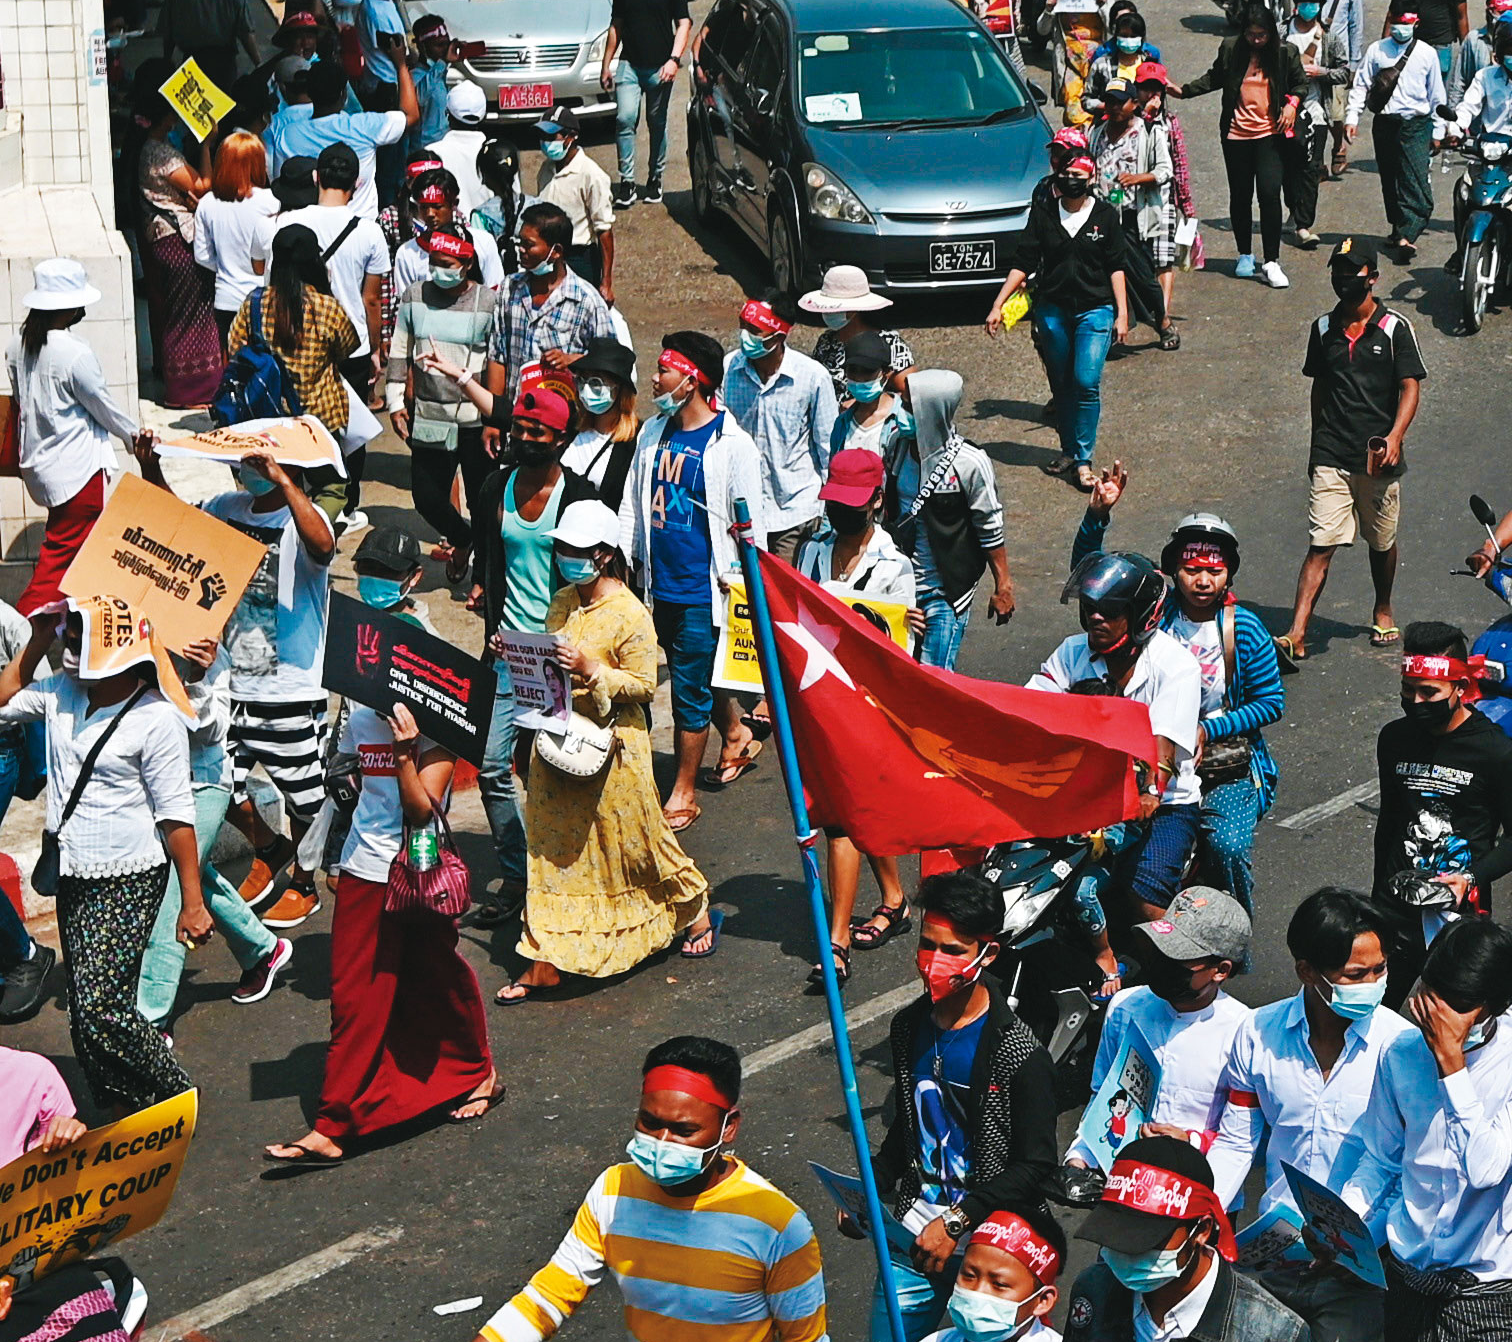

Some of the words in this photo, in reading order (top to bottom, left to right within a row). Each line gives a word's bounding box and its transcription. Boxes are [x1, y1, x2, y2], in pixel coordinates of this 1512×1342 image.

[934, 250, 992, 271] 3E-7574
[953, 244, 974, 254] YGN
[388, 681, 424, 705] JUSTICE
[426, 698, 443, 716] FOR
[444, 709, 478, 736] MYANMAR
[389, 667, 409, 686] CIVIL
[413, 679, 469, 717] DISOBEDIENCE
[514, 685, 546, 702] REJECT
[21, 1143, 90, 1196] Don't
[95, 1116, 187, 1169] Accept
[97, 1163, 173, 1214] COUP
